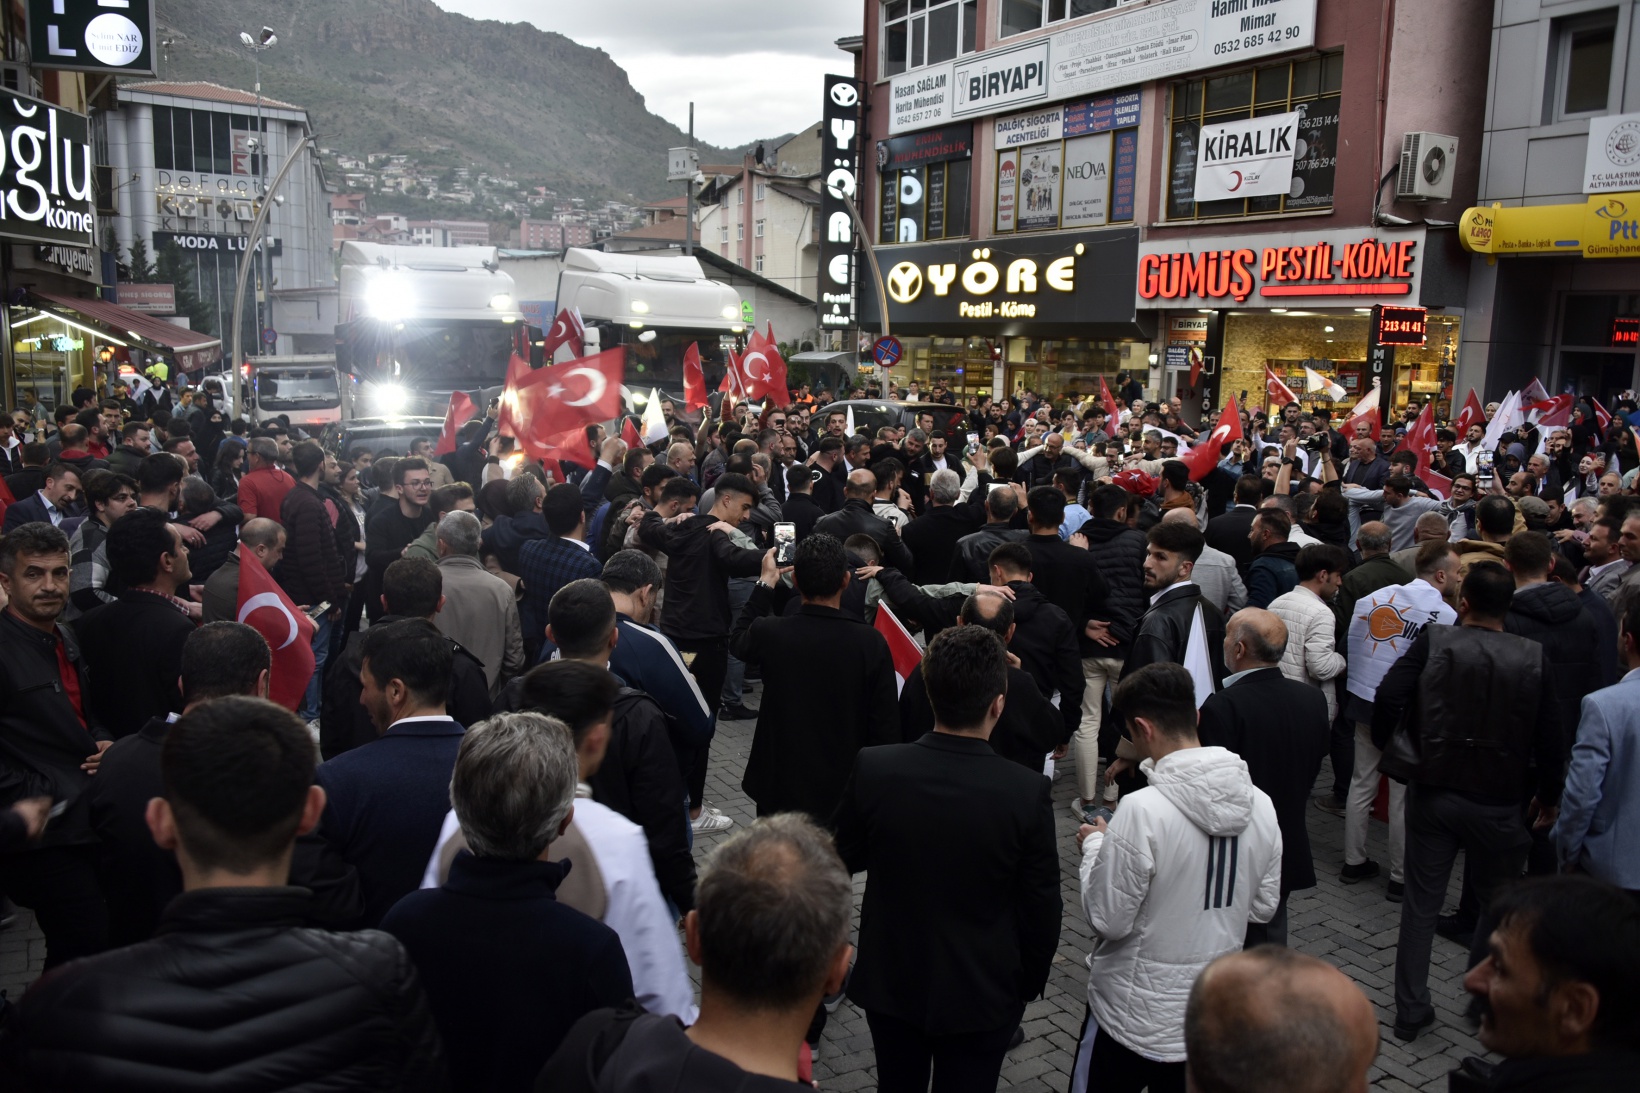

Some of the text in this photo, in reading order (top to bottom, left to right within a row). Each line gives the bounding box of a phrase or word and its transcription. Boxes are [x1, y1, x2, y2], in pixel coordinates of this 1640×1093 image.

[1240, 13, 1277, 33] Mimar
[117, 33, 138, 42] NAR
[1056, 22, 1114, 47] MÜHENDİSLİK
[1214, 25, 1300, 55] 0532 685 42 90
[115, 44, 139, 54] EDİZ
[1071, 60, 1082, 69] Proje
[969, 61, 1044, 101] BİRYAPI
[1102, 69, 1138, 85] TESİSAT
[895, 74, 947, 99] Hasan SAĞLAM
[895, 92, 945, 113] Harita Mühendisi
[1115, 93, 1139, 105] SİGORTA
[897, 107, 942, 125] 0542 657 27 06
[997, 111, 1061, 133] DALĞIÇ SİGORTA
[1116, 115, 1137, 125] YAPILIR
[1298, 119, 1312, 131] 456
[1312, 116, 1324, 128] 213
[1324, 115, 1334, 126] 14
[1005, 127, 1050, 145] ACENTELİĞİ
[1204, 125, 1293, 162] KİRALIK
[0, 97, 93, 222] ğlu
[1294, 160, 1307, 171] 507
[1320, 157, 1330, 168] 29
[1001, 169, 1015, 179] RAY
[1066, 161, 1107, 180] NEOVA
[1592, 173, 1604, 181] T.C.
[1588, 180, 1618, 190] ALTYAPI
[826, 117, 856, 285] YÖRE
[45, 199, 94, 234] köme
[1484, 217, 1493, 228] Ptt
[1470, 226, 1492, 239] KARGO
[1609, 220, 1639, 241] Ptt
[174, 235, 218, 250] MODA
[1502, 239, 1551, 249] Posta Banka Lojistik
[1587, 243, 1640, 256] Gümüşhane
[928, 247, 1076, 296] YÖRE
[1138, 239, 1416, 302] GÜMÜŞ PESTİL-KÖME
[119, 290, 139, 300] ÜNEŞ
[959, 301, 992, 318] Pestil
[1000, 301, 1036, 318] Köme
[823, 314, 850, 325] Köme
[1177, 321, 1208, 329] BİRYAP
[1384, 320, 1421, 332] 213 41 41
[1301, 358, 1333, 374] GÜMÜŞ
